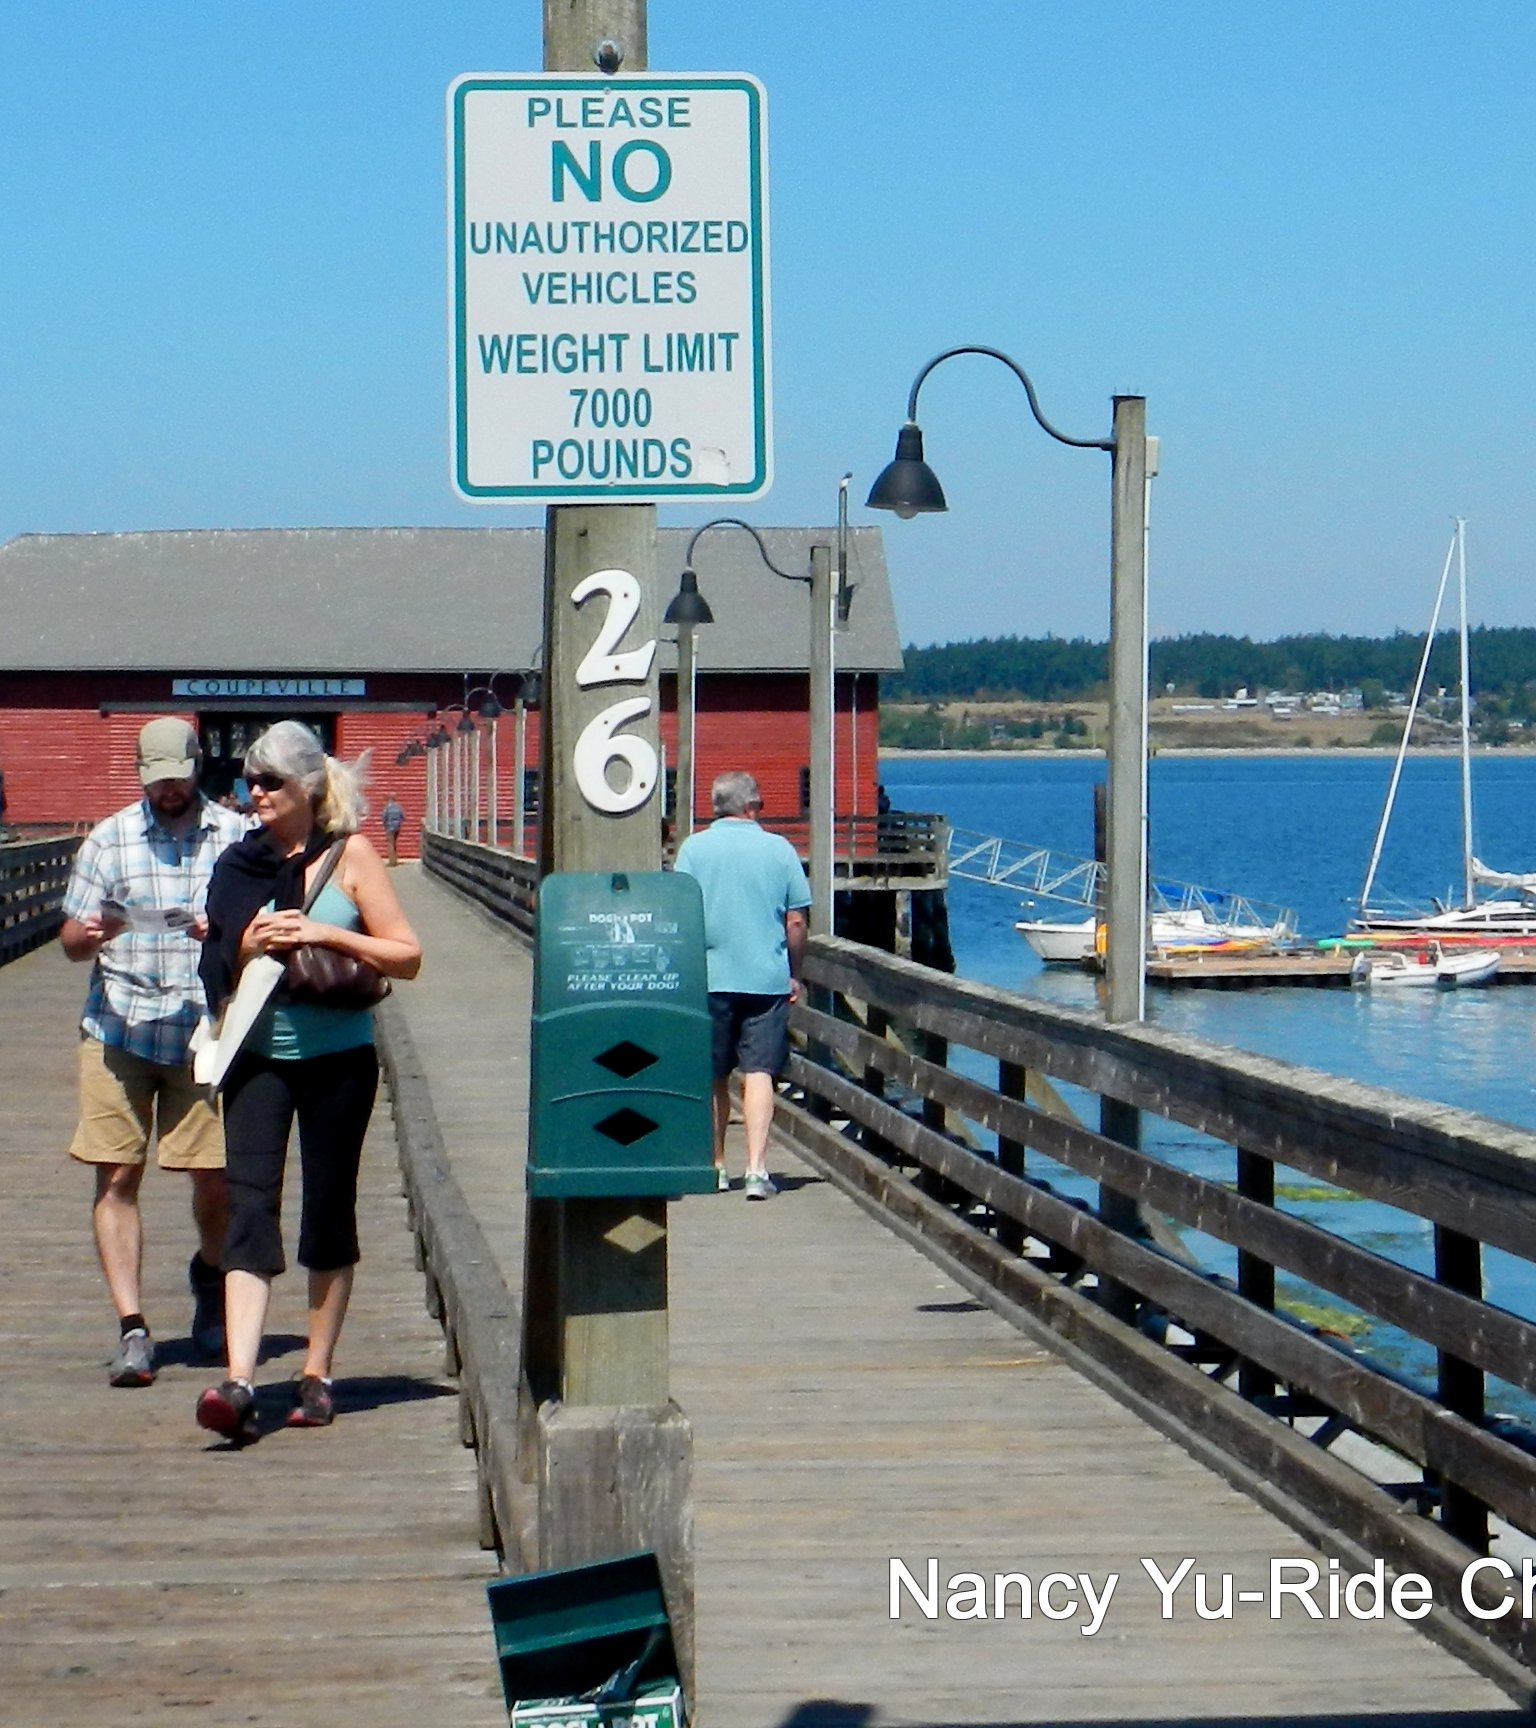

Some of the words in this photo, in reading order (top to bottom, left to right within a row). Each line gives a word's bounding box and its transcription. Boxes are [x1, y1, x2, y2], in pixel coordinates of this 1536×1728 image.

[527, 97, 692, 129] PLEASE
[551, 138, 673, 203] NO
[469, 220, 749, 254] UNAUTHORIZED
[522, 271, 697, 304] VEHICLES
[478, 333, 630, 374] WEIGHT
[643, 332, 740, 373] LIMIT
[569, 388, 653, 428] 7000
[532, 437, 693, 480] POUNDS
[187, 679, 351, 696] COUPEVILLE
[567, 973, 612, 982] PLEASE
[617, 973, 658, 982] CLEAN
[662, 972, 680, 981] UP
[567, 982, 606, 991] AFTER
[610, 982, 644, 991] YOUR
[647, 981, 680, 991] DOG!
